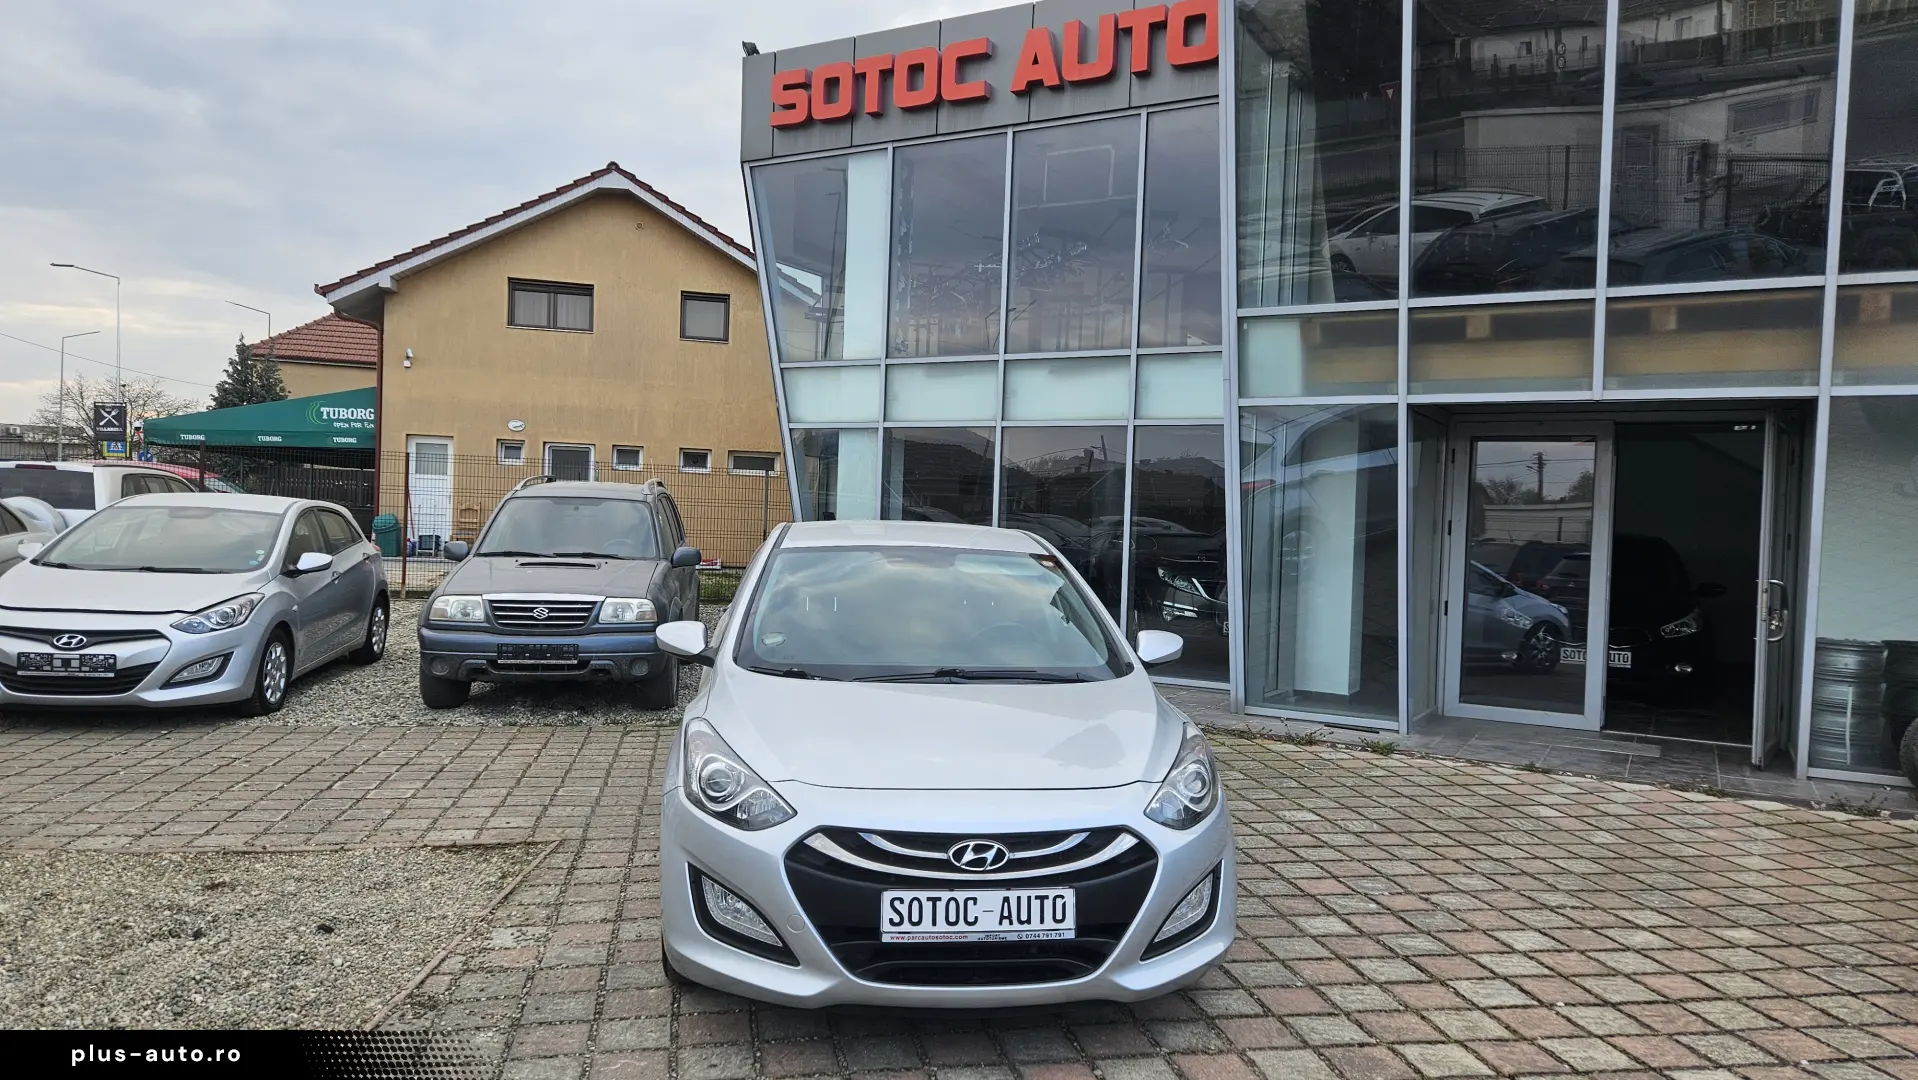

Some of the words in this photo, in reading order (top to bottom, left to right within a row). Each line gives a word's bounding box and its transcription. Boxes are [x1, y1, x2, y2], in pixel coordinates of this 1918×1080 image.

[770, 37, 992, 128] SOTOC
[1011, 0, 1219, 96] AUTO
[320, 407, 375, 420] TUBORG
[333, 421, 349, 429] OPEN
[890, 934, 969, 942] www.parcautosotoc.com
